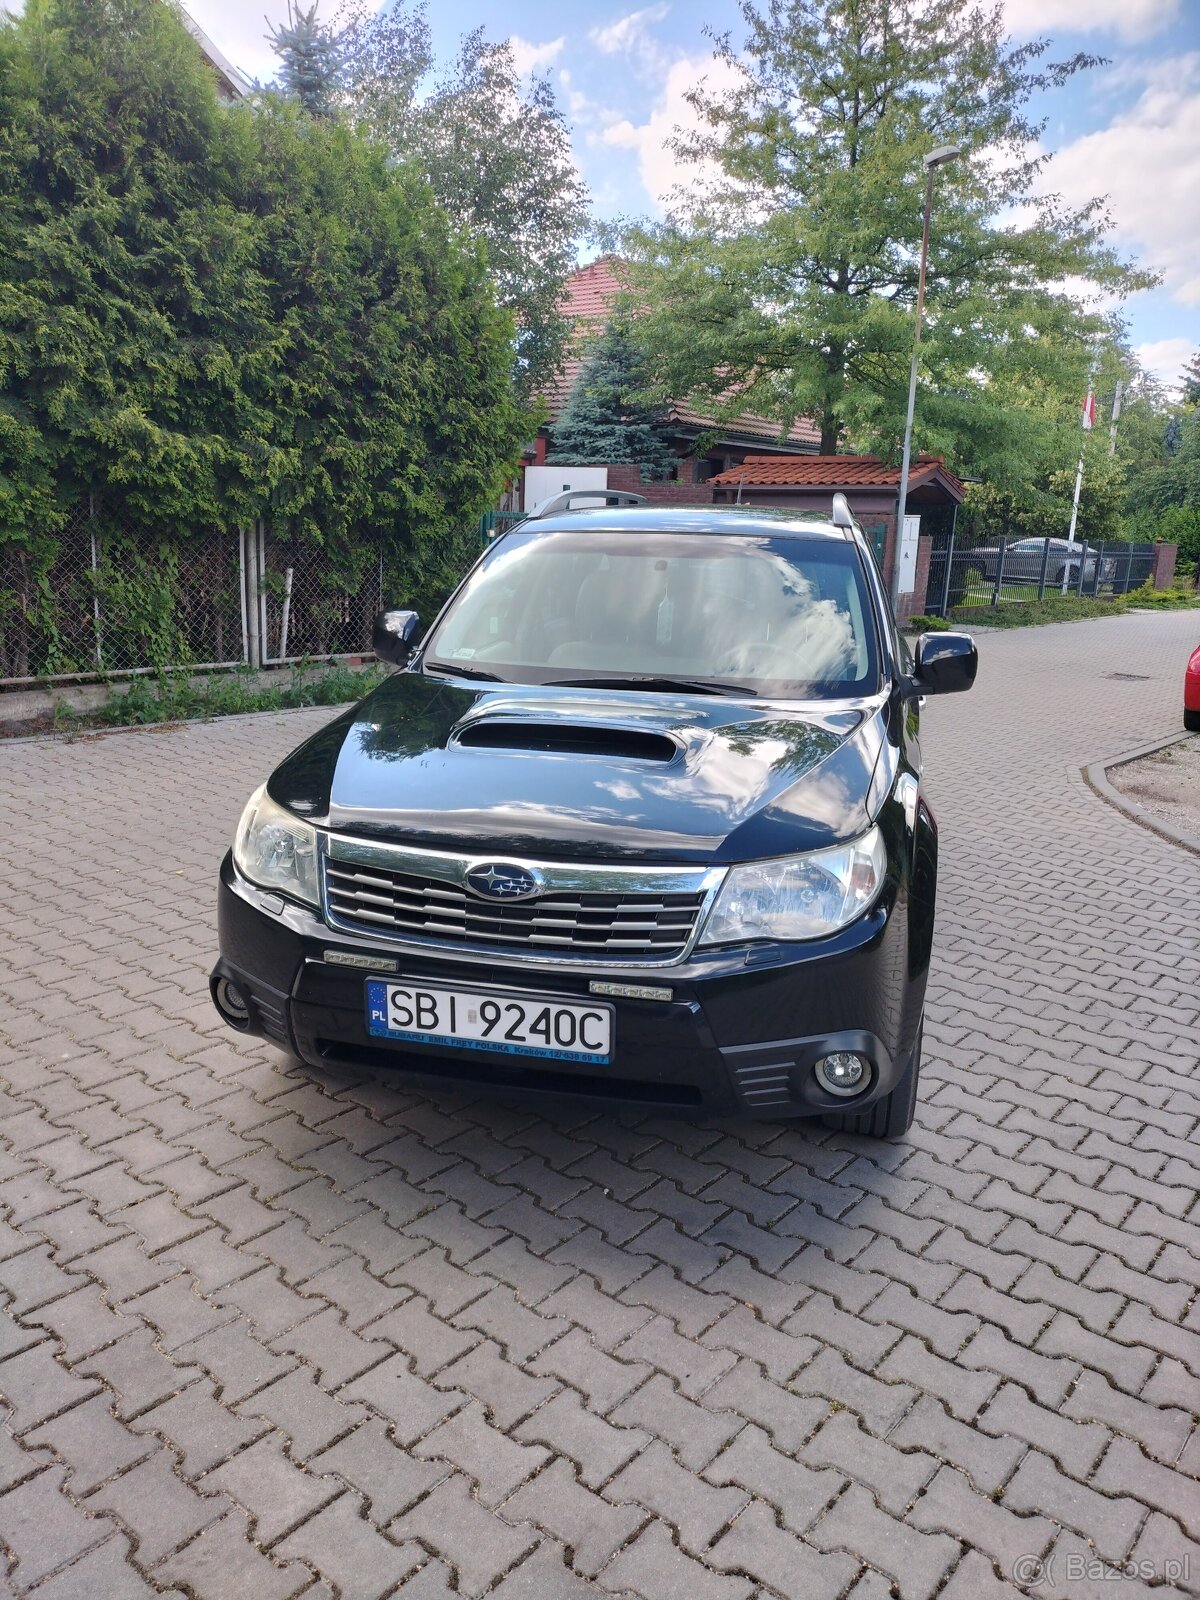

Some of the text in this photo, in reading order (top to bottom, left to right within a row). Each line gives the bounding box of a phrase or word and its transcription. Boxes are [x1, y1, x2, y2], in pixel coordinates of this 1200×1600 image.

[372, 1010, 386, 1021] PL
[479, 1000, 604, 1050] 9240C
[388, 1031, 425, 1041] SUBARU
[428, 1036, 449, 1045] EMIL
[451, 1039, 473, 1047] FREY
[475, 1041, 510, 1053] POLSKA
[514, 1045, 547, 1057] Kraków
